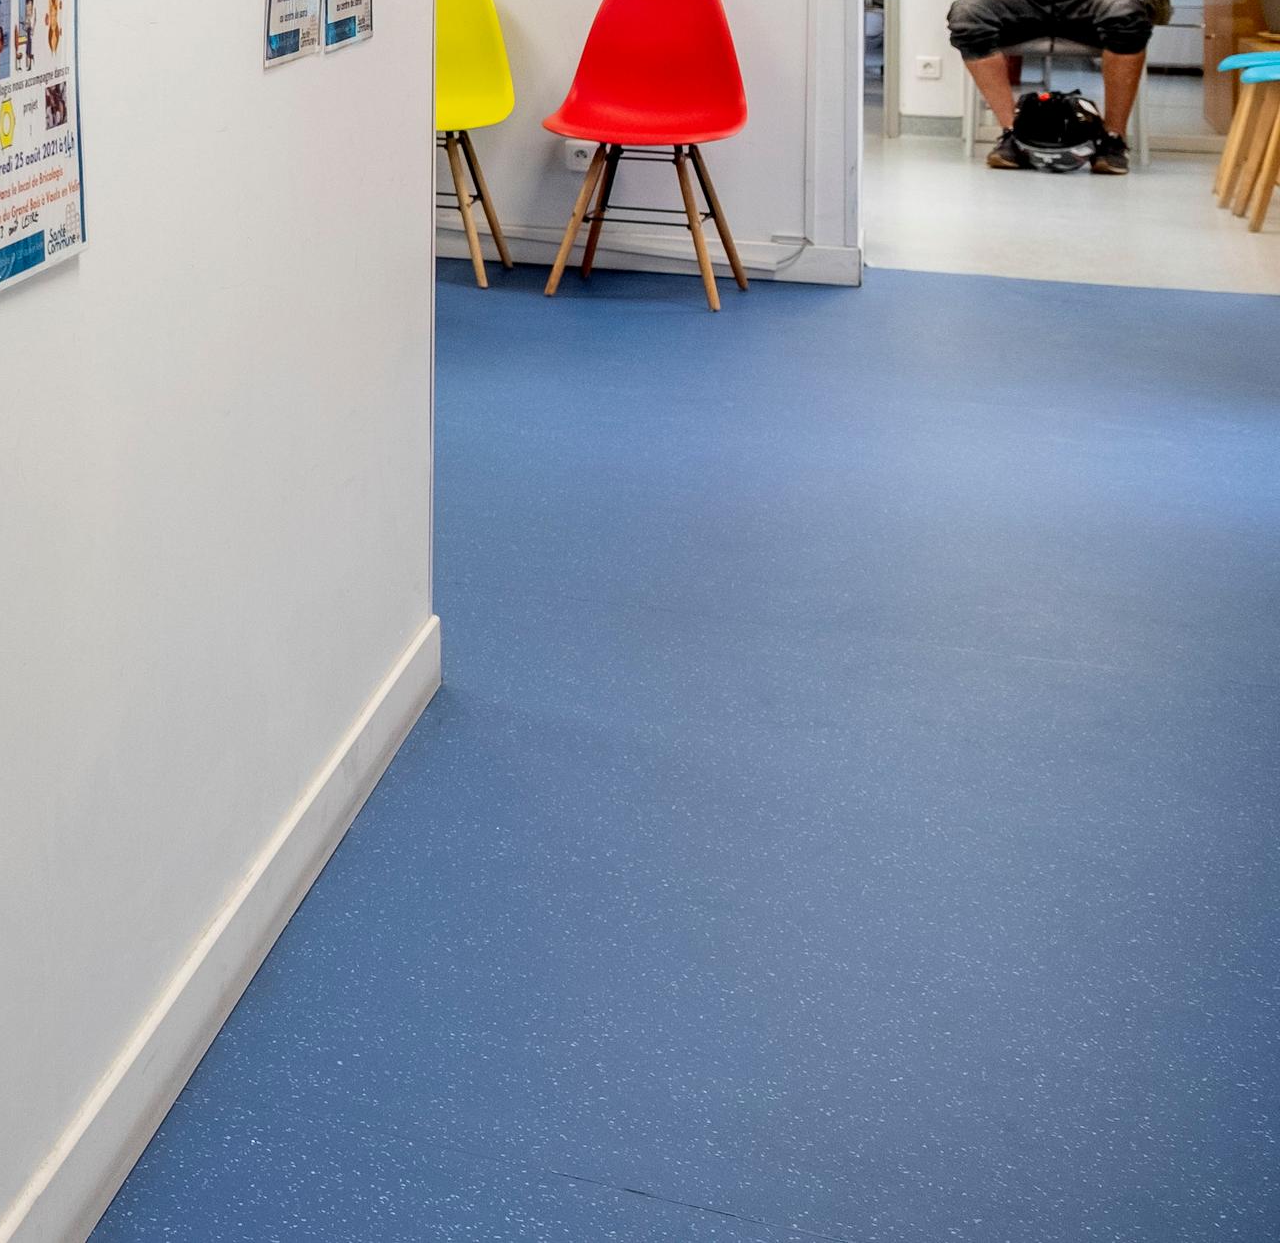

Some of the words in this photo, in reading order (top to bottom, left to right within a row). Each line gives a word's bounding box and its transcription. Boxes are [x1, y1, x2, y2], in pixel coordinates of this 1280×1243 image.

[14, 152, 24, 170] 25
[26, 145, 41, 166] août
[42, 139, 59, 160] 2021
